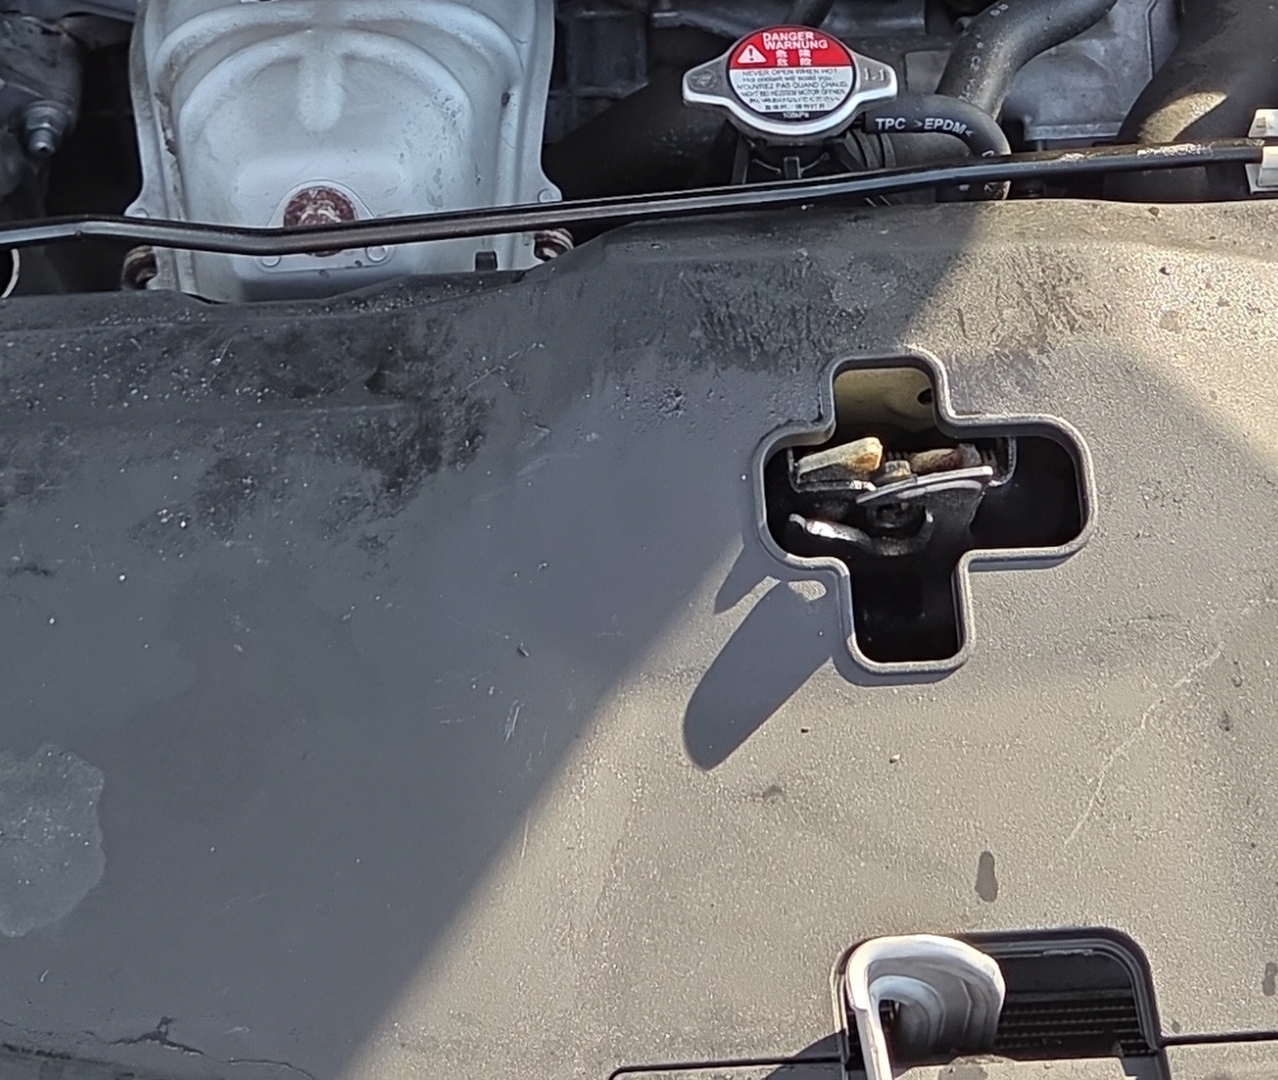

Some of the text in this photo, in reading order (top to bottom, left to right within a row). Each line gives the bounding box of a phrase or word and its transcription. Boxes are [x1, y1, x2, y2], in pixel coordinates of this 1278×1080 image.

[762, 31, 814, 41] DANGER
[764, 39, 828, 50] WARNUNG
[863, 67, 885, 81] 1.1
[792, 81, 820, 89] QUAND
[875, 117, 974, 137] TPC >EPDM<
